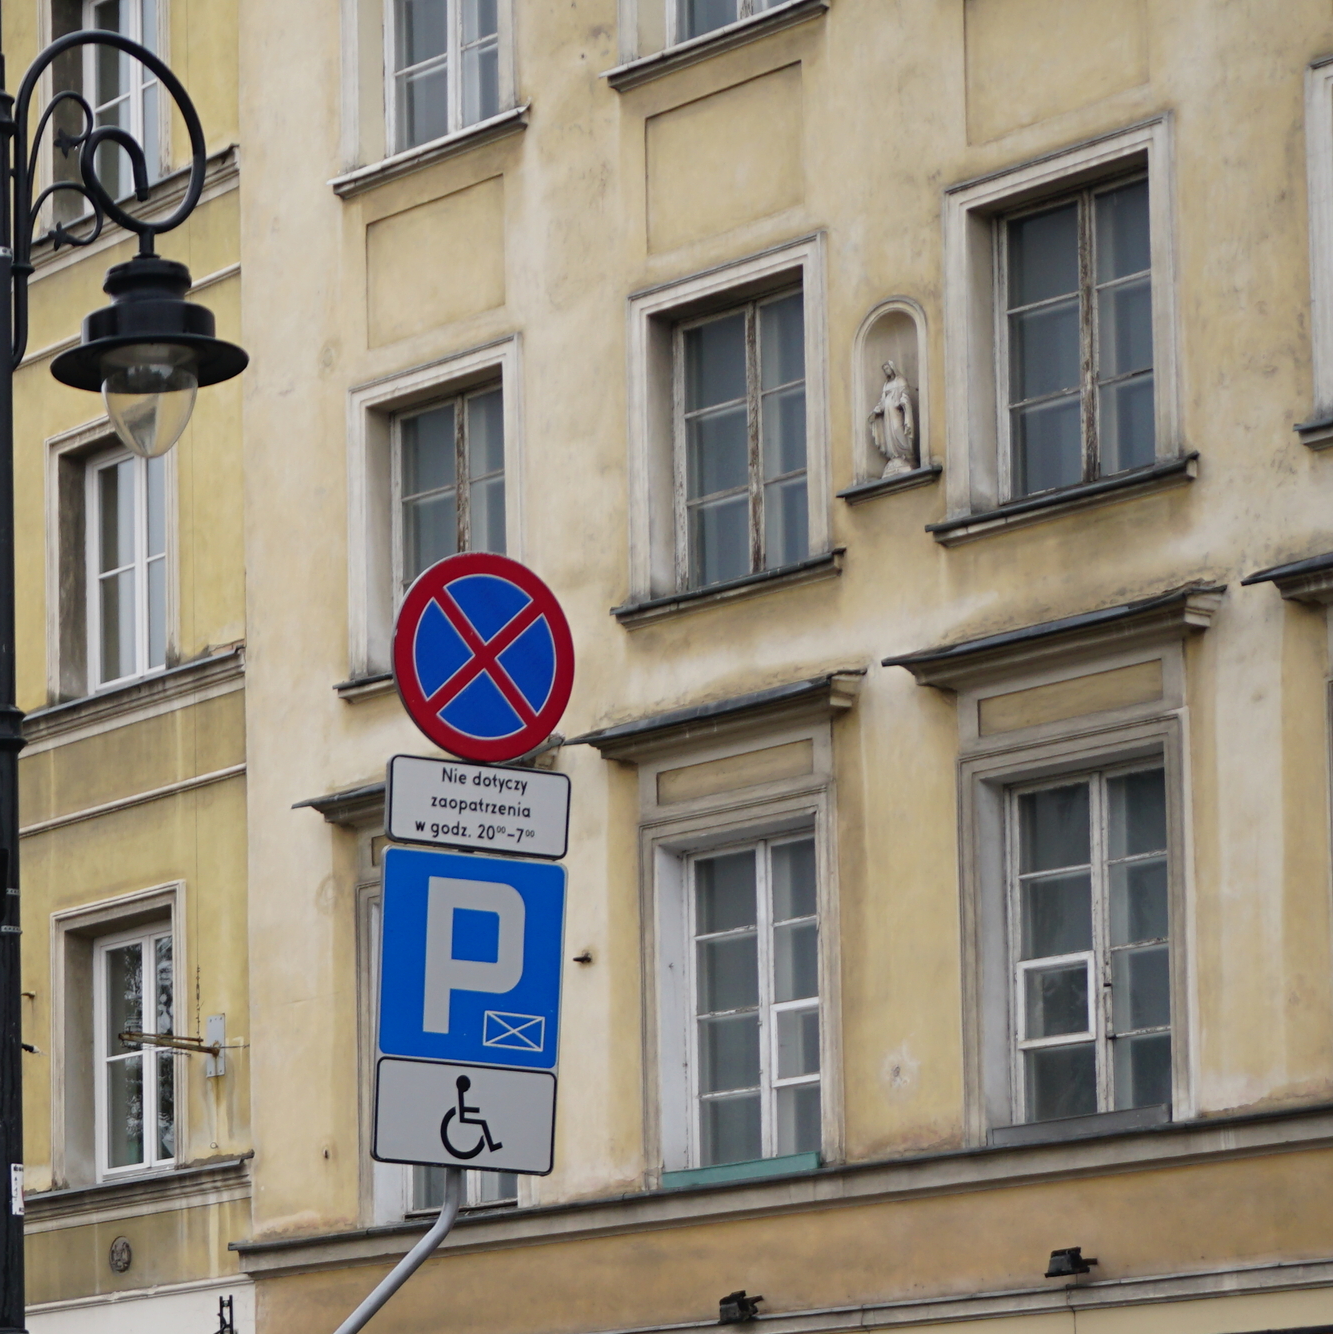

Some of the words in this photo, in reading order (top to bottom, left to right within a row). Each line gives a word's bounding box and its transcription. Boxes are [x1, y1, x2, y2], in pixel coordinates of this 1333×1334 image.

[442, 767, 467, 785] Nie
[472, 771, 528, 796] dotyczy
[431, 796, 531, 818] zaopatrzenia
[415, 820, 426, 832] w
[431, 821, 471, 838] godz.
[422, 875, 526, 1034] P
